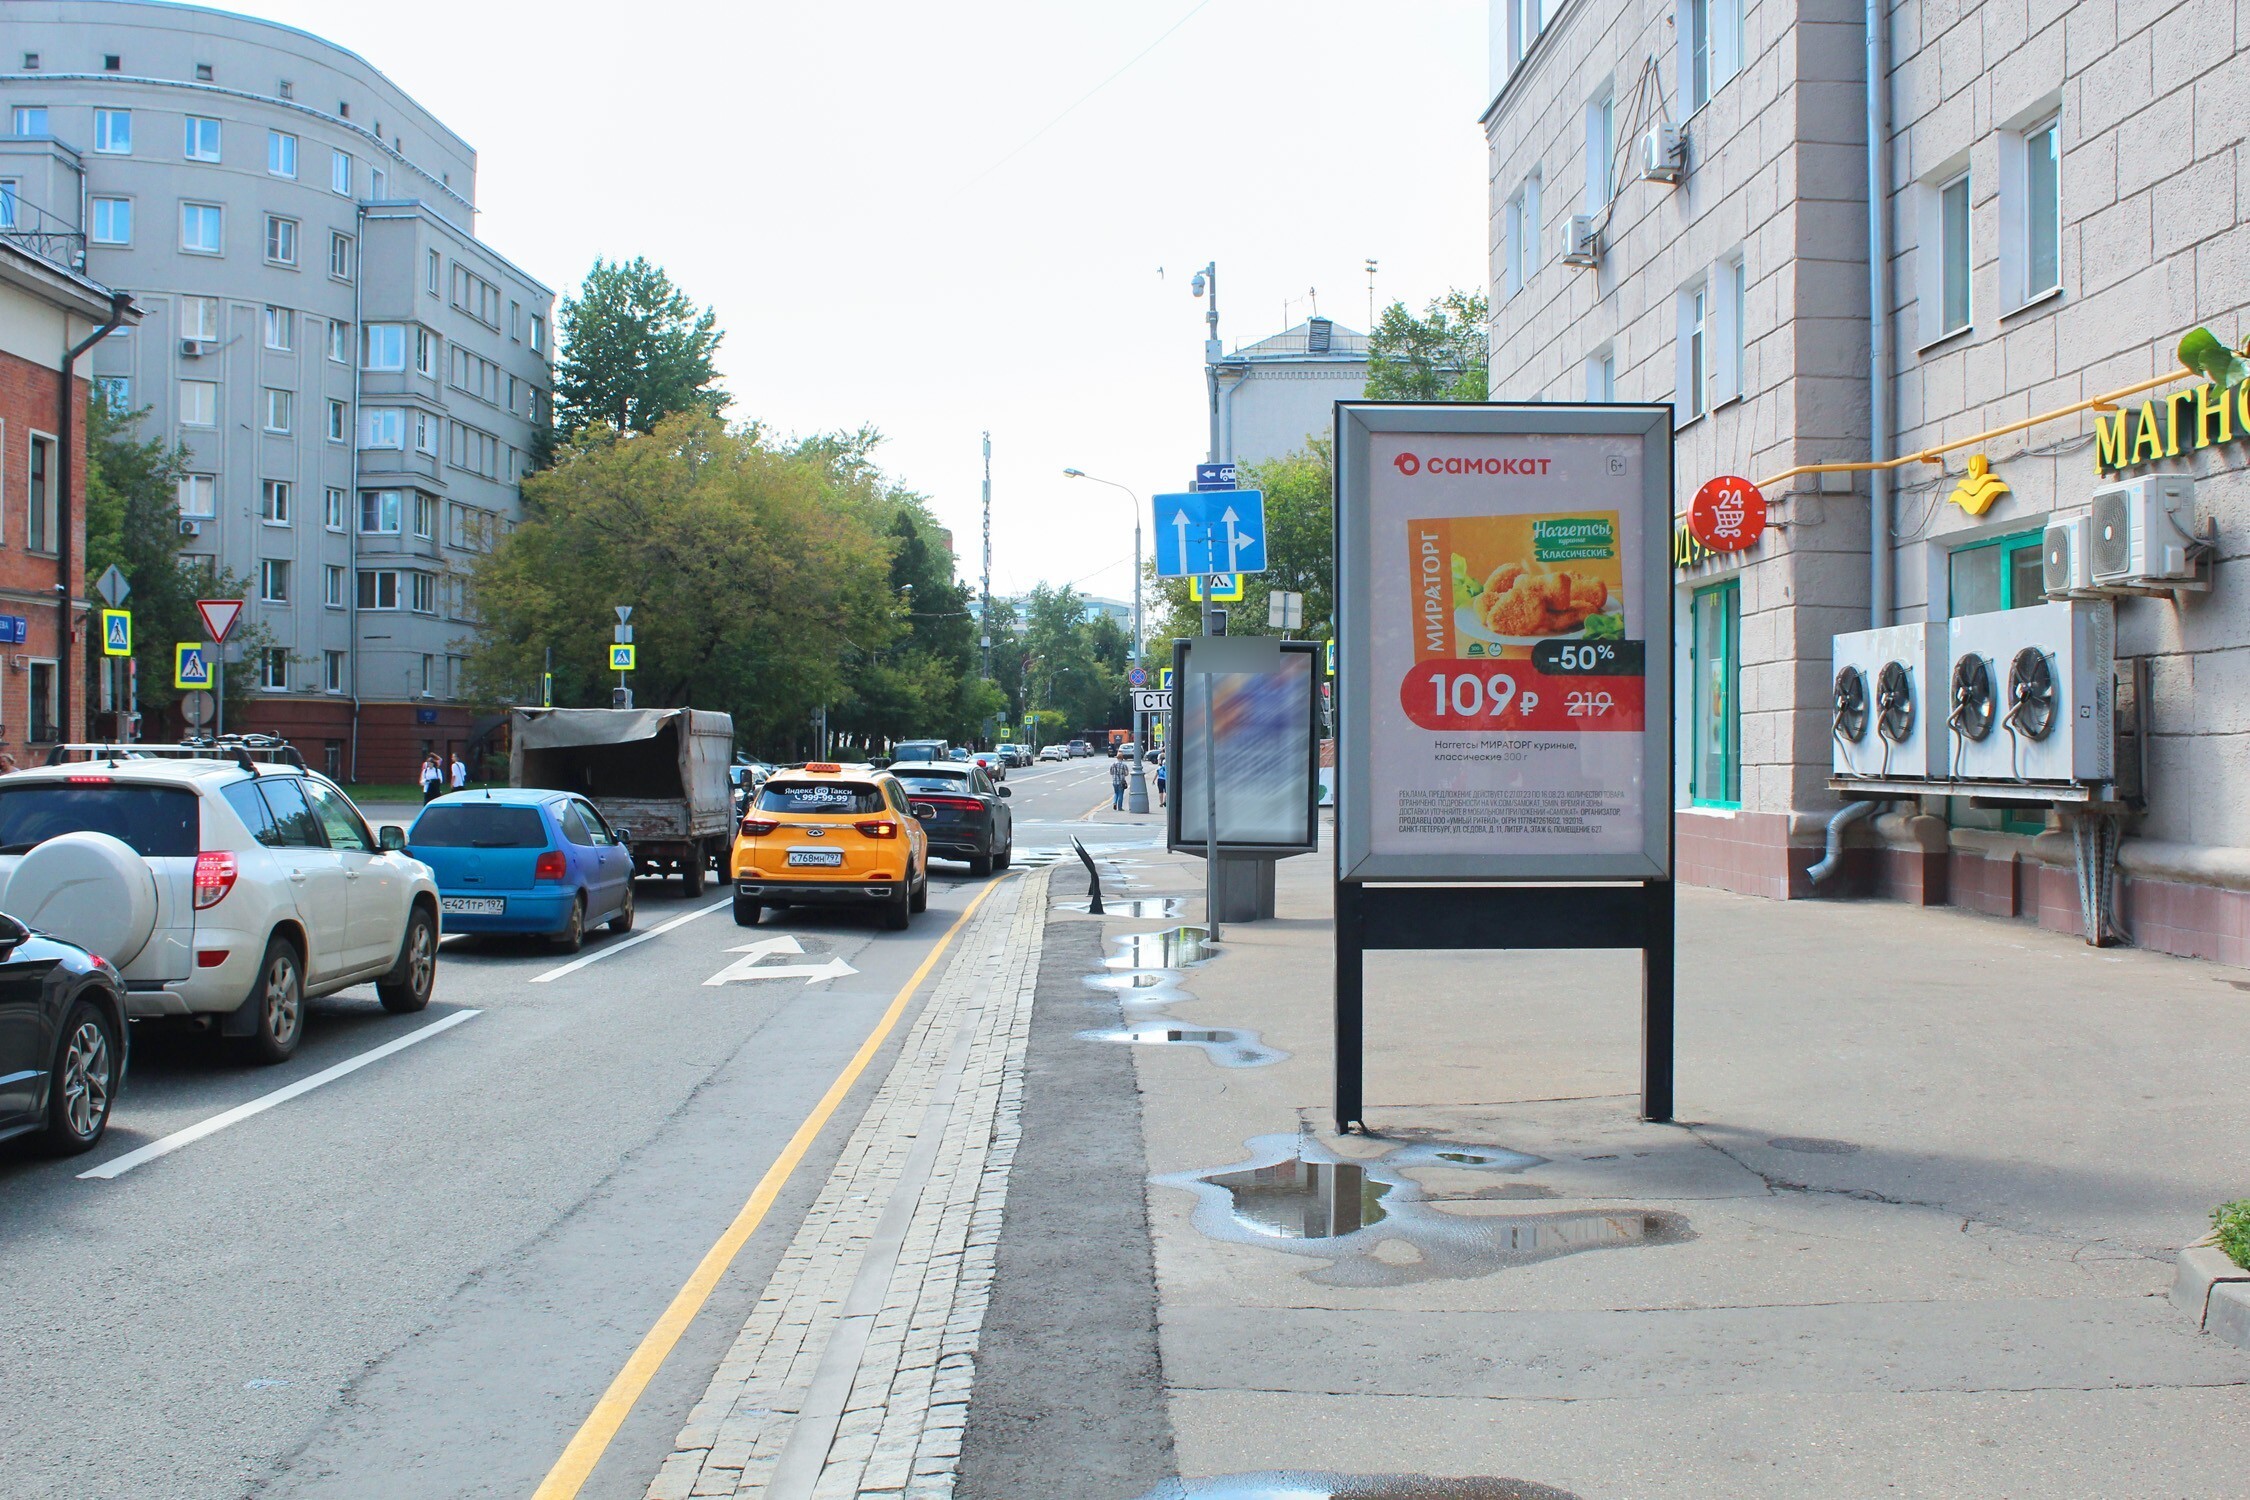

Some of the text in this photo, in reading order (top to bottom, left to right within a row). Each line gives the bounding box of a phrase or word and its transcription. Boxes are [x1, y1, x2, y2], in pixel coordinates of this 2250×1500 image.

[1427, 457, 1552, 475] самокат
[1610, 459, 1623, 472] 6+
[1718, 489, 1744, 509] 24
[1534, 520, 1612, 539] Наггетсы
[1421, 531, 1445, 652] МИРАТОРГ
[16, 621, 25, 635] 27
[1548, 645, 1615, 670] -50%
[1565, 691, 1614, 717] 219
[1434, 740, 1577, 751] Наггетсы МИРАТОРГ куриные,
[1434, 752, 1502, 761] классические
[1504, 752, 1522, 761] 300
[784, 787, 813, 795] Яндекс
[830, 787, 853, 795] Такси
[802, 794, 848, 802] 999-99-99
[1399, 816, 1432, 825] ПРОДАВЕЦ
[1530, 825, 1546, 833] ЭТАЖ
[1553, 825, 1591, 834] ПОМЕЩЕНИЕ
[826, 853, 839, 861] 797
[445, 899, 502, 910] Е421ТР 197
